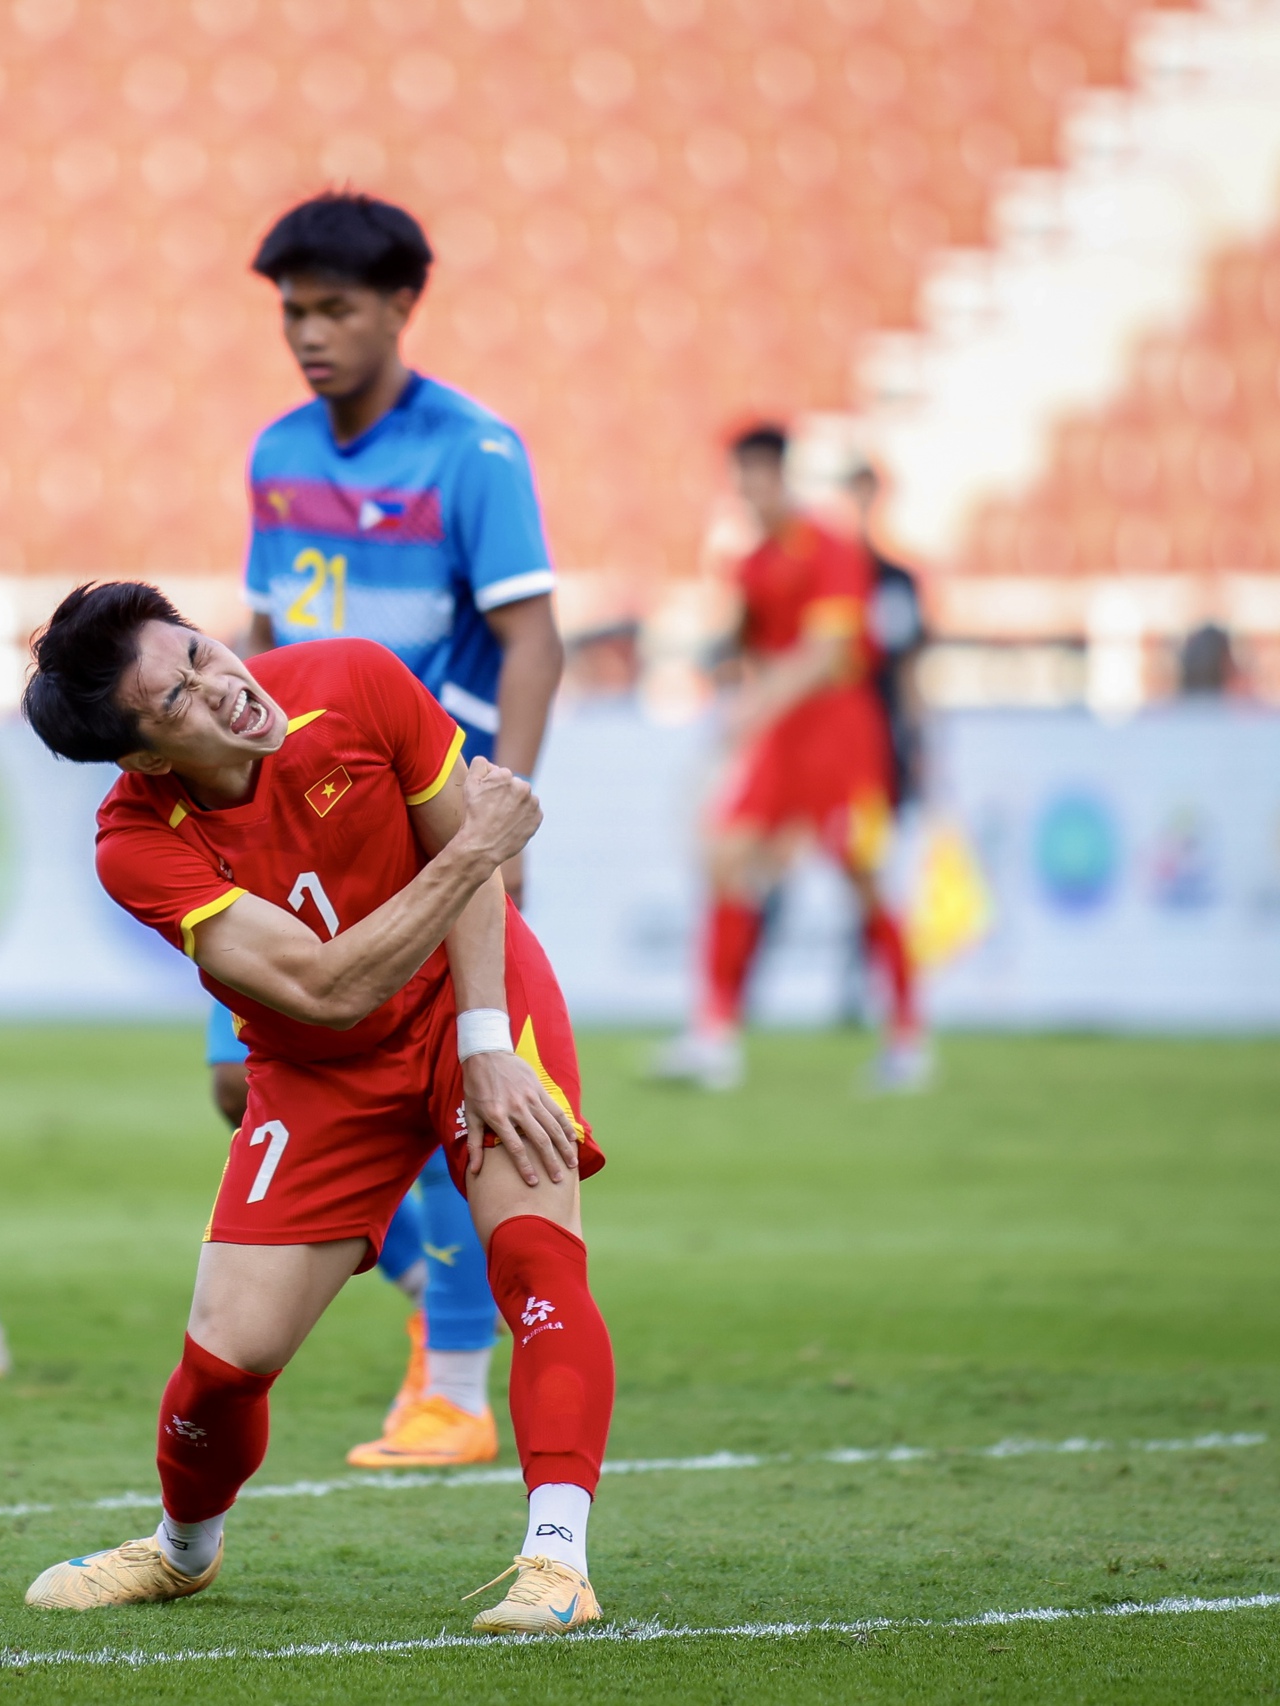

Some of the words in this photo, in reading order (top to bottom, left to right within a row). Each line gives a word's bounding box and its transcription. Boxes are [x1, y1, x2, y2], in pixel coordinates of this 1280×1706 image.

[285, 547, 348, 632] 21
[287, 871, 340, 938] 7
[246, 1119, 290, 1204] 7
